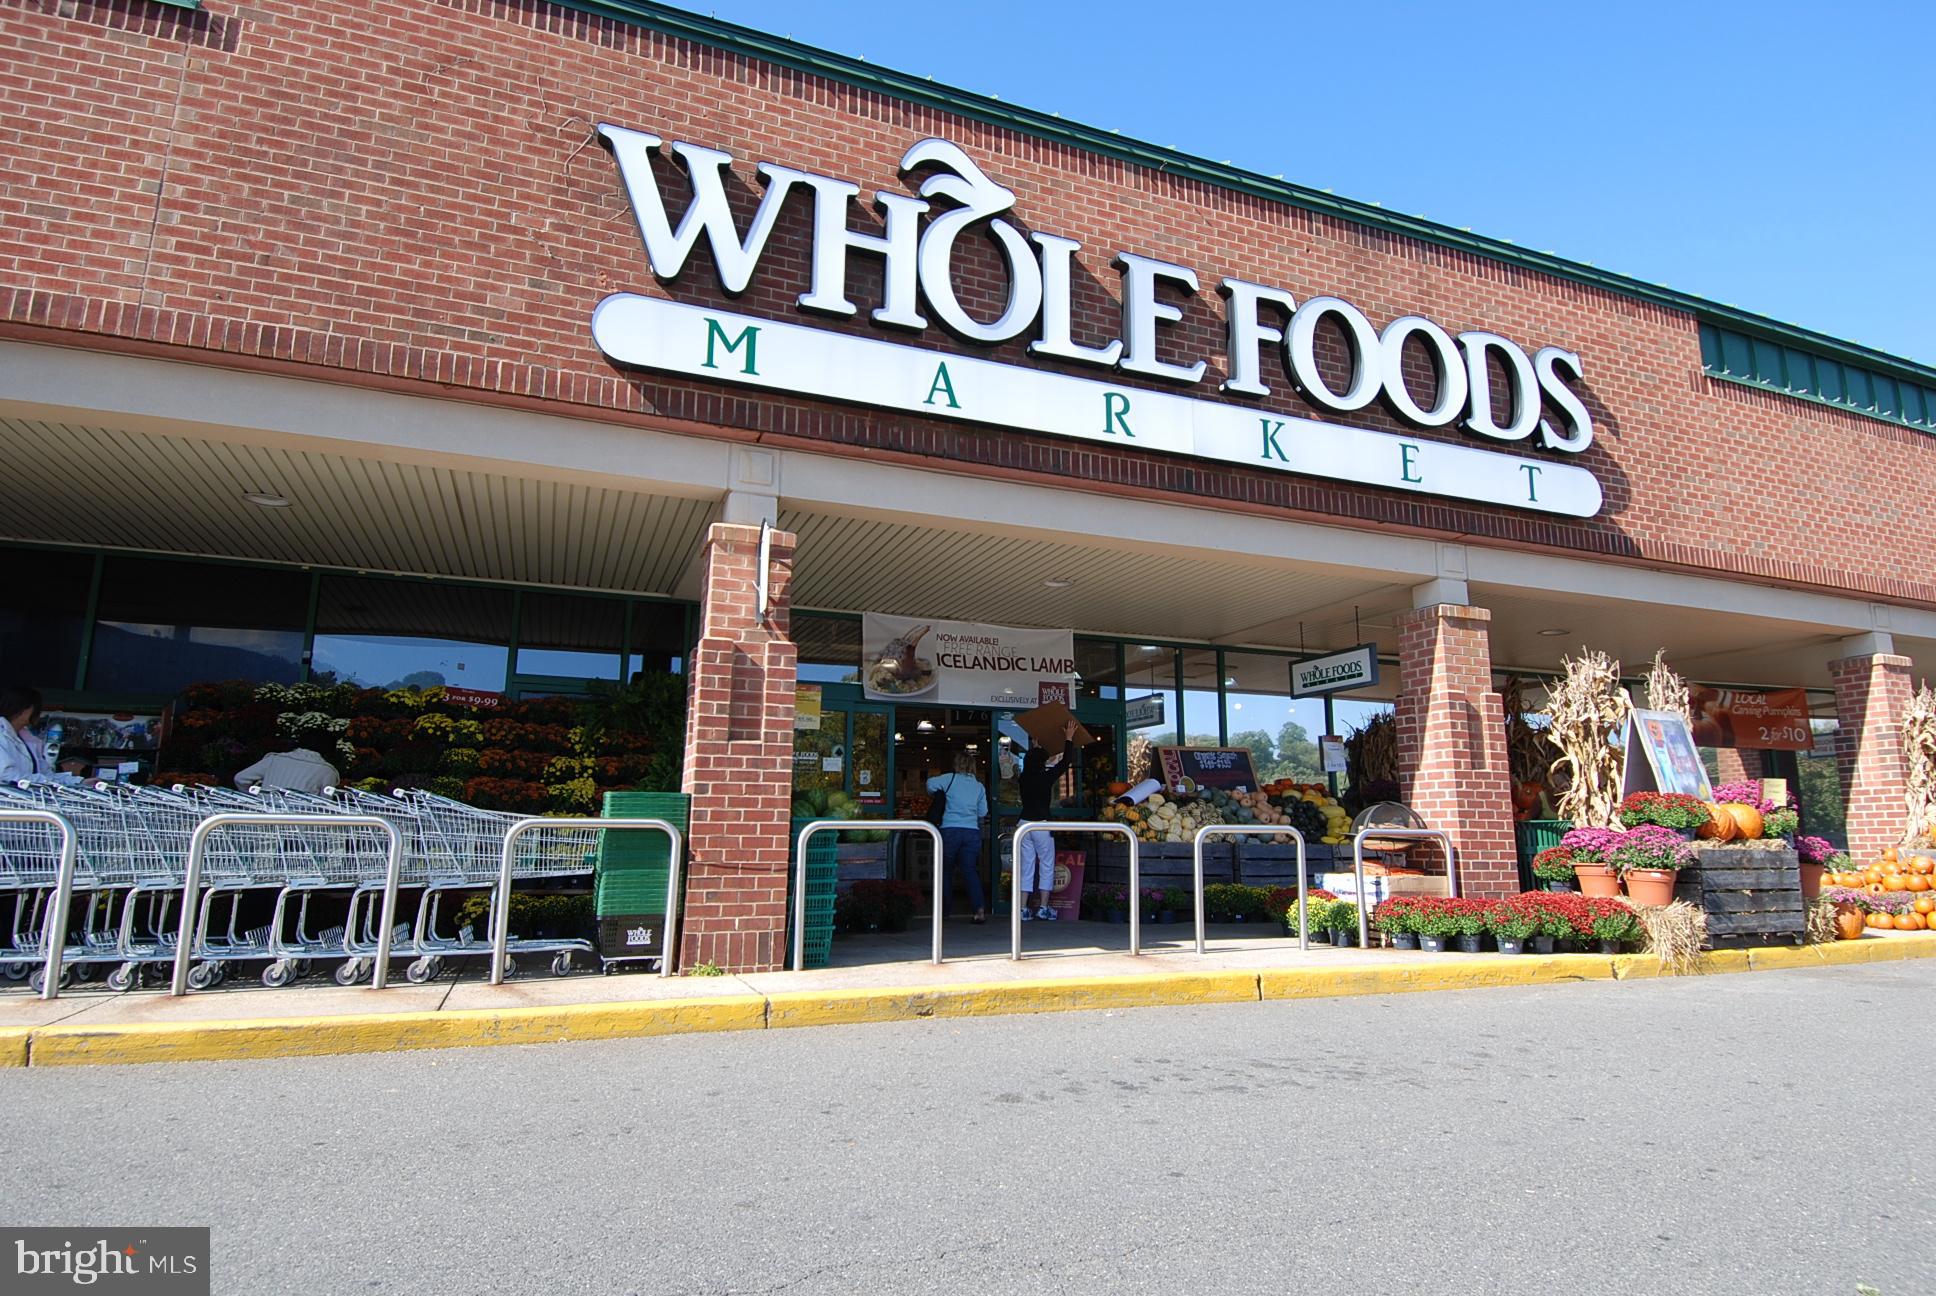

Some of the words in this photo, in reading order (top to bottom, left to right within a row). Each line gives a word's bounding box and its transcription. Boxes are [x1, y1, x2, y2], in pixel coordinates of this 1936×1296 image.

[597, 122, 1207, 386] WHOLE
[1215, 278, 1593, 455] FOODS
[701, 318, 1543, 503] MARKET
[936, 633, 958, 642] NOW
[959, 636, 999, 646] AVAILABLE!
[944, 642, 972, 656] FREE
[976, 644, 1018, 658] RANGE
[936, 653, 1028, 672] ICELANDIC
[1031, 657, 1075, 674] LAMB
[1300, 665, 1331, 683] WHOLE
[1332, 661, 1362, 677] FOODS
[1042, 686, 1065, 696] WHOLE
[468, 696, 498, 706] $9.99
[991, 695, 1029, 705] EXCLUSIVELY
[1030, 697, 1038, 705] AT
[1042, 695, 1065, 704] FOODS
[1735, 694, 1767, 705] LOCAL
[1732, 705, 1761, 718] Carving
[1762, 706, 1802, 718] Pumpkins
[1758, 726, 1769, 740] 2
[1768, 727, 1782, 744] for
[1783, 727, 1806, 742] $10
